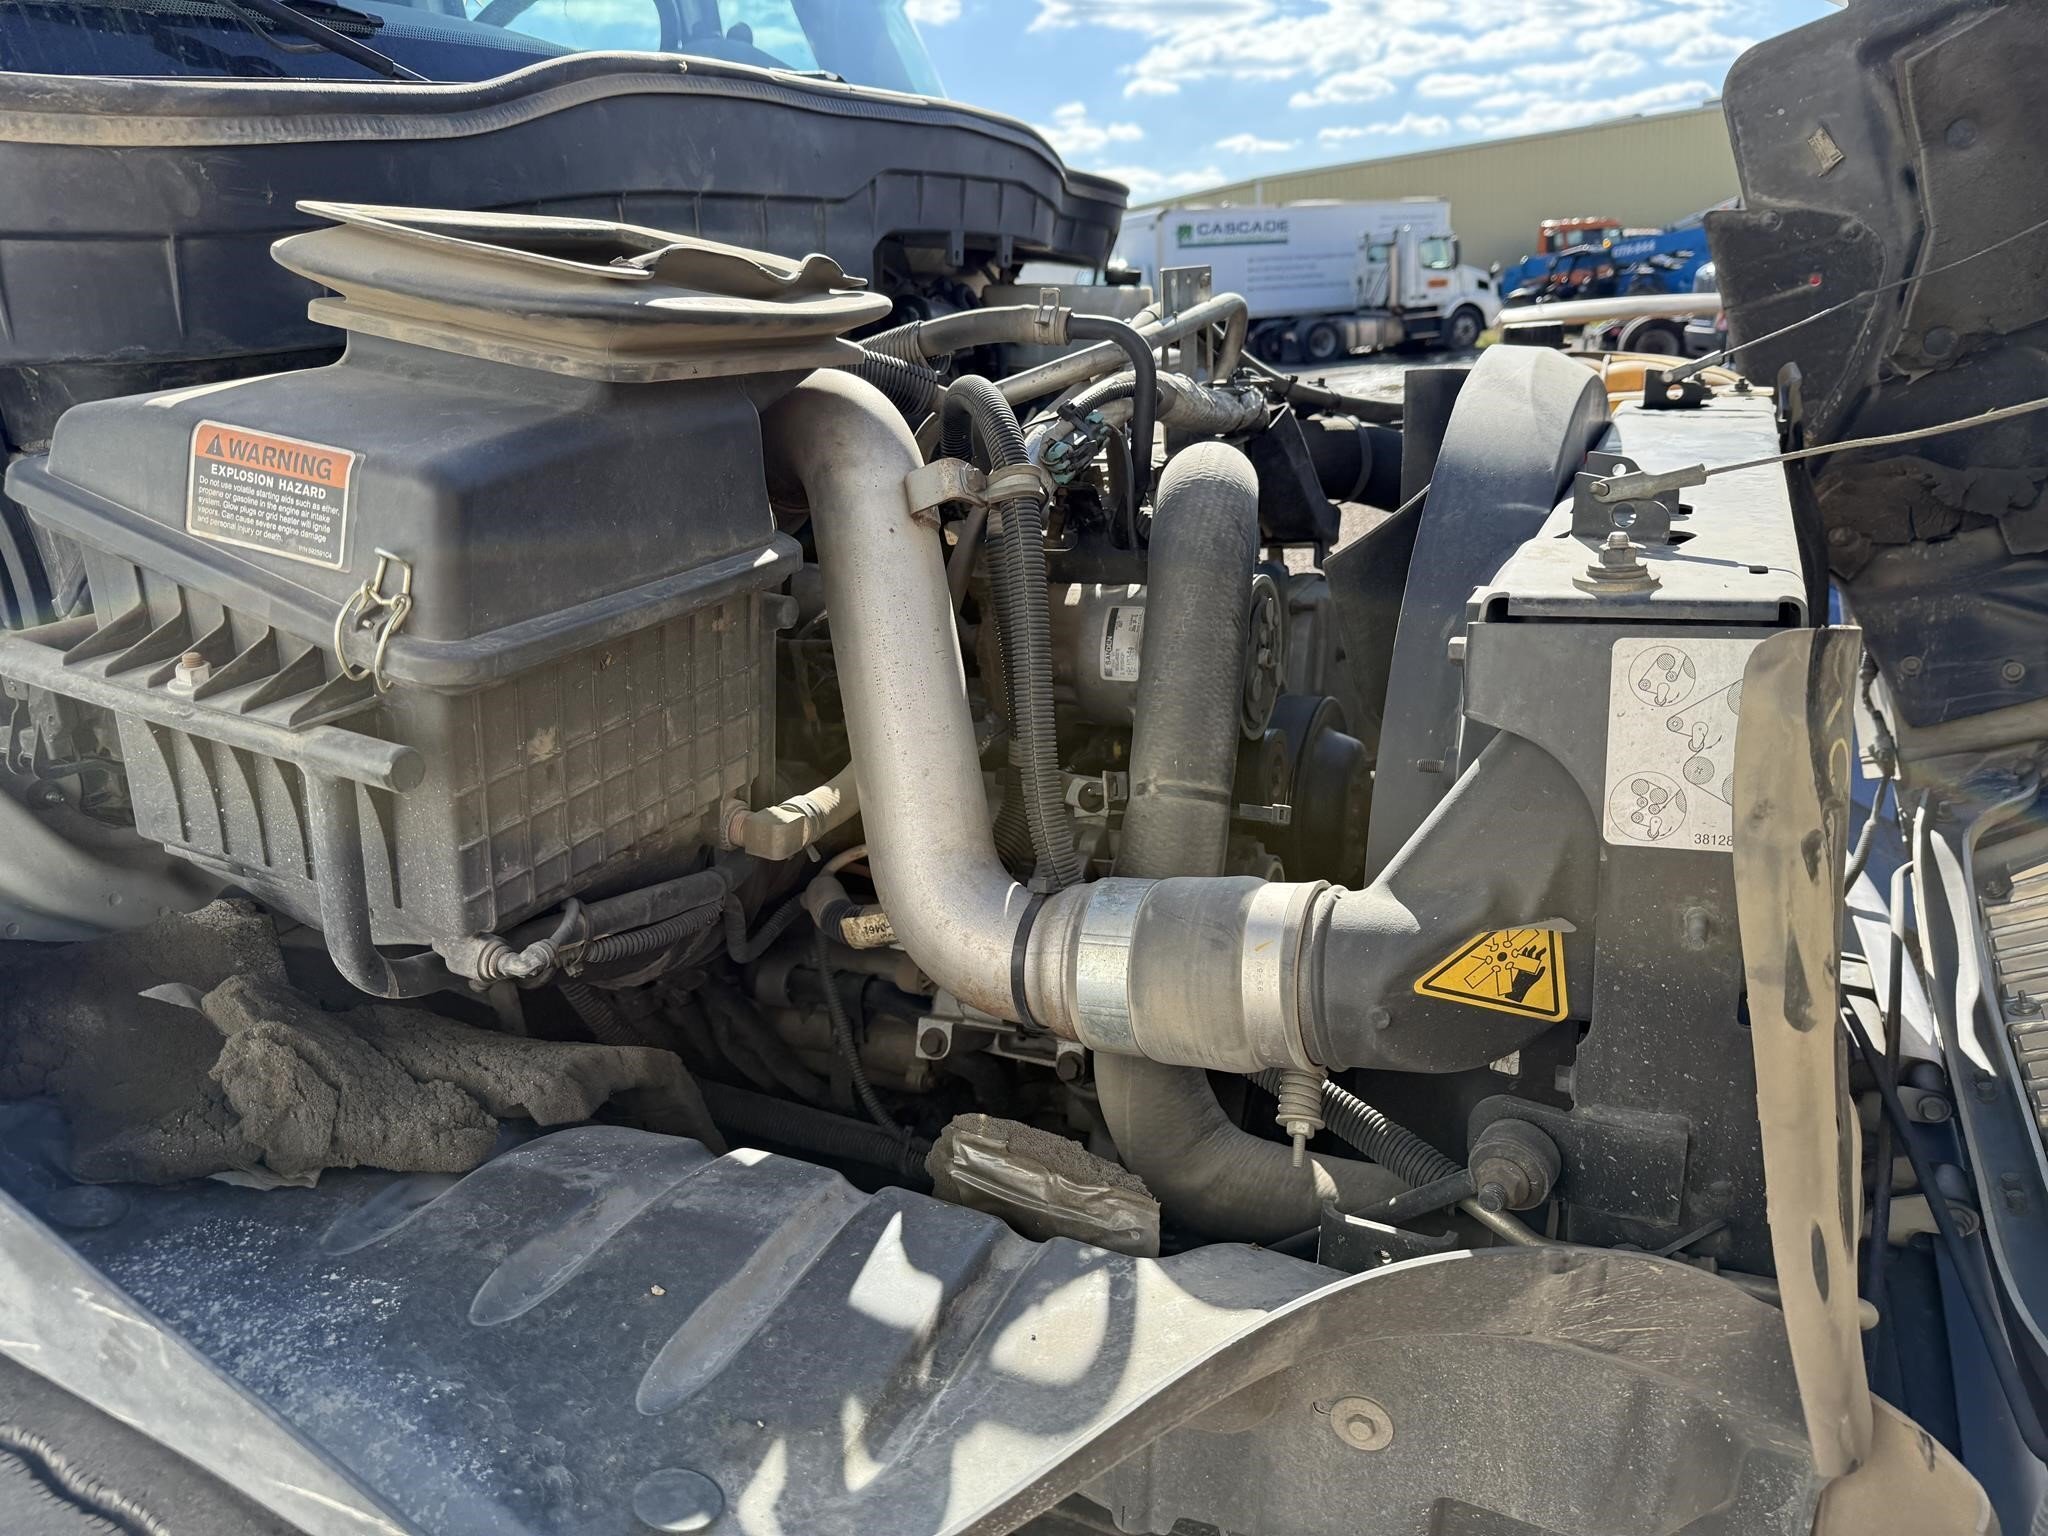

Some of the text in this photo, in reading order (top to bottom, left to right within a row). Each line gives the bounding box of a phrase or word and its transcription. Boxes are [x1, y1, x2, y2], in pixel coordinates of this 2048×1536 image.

[1197, 220, 1289, 236] CASCADE
[229, 438, 332, 480] WARNING
[199, 475, 209, 485] Do
[209, 479, 220, 487] not
[220, 482, 232, 490] use
[233, 484, 255, 495] volatile
[256, 489, 280, 502] starting
[281, 494, 294, 505] aids
[295, 499, 311, 509] such
[312, 502, 320, 511] as
[211, 463, 326, 500] EXPLOSION HAZARD
[199, 486, 331, 524] propane or gasoline in the engine air intake
[222, 500, 239, 511] Glow
[239, 505, 257, 517] plugs
[257, 510, 265, 518] or
[265, 511, 278, 521] grid
[279, 514, 300, 526] heater
[300, 519, 312, 529] will
[312, 521, 331, 534] ignite
[209, 518, 237, 530] personal
[237, 523, 255, 537] injury
[255, 529, 263, 537] or
[221, 509, 234, 520] Can
[235, 514, 255, 525] cause
[255, 519, 277, 531] severe
[277, 524, 300, 536] engine
[300, 529, 327, 544] damage
[1104, 635, 1113, 665] SANDEN
[1694, 833, 1733, 847] 38128
